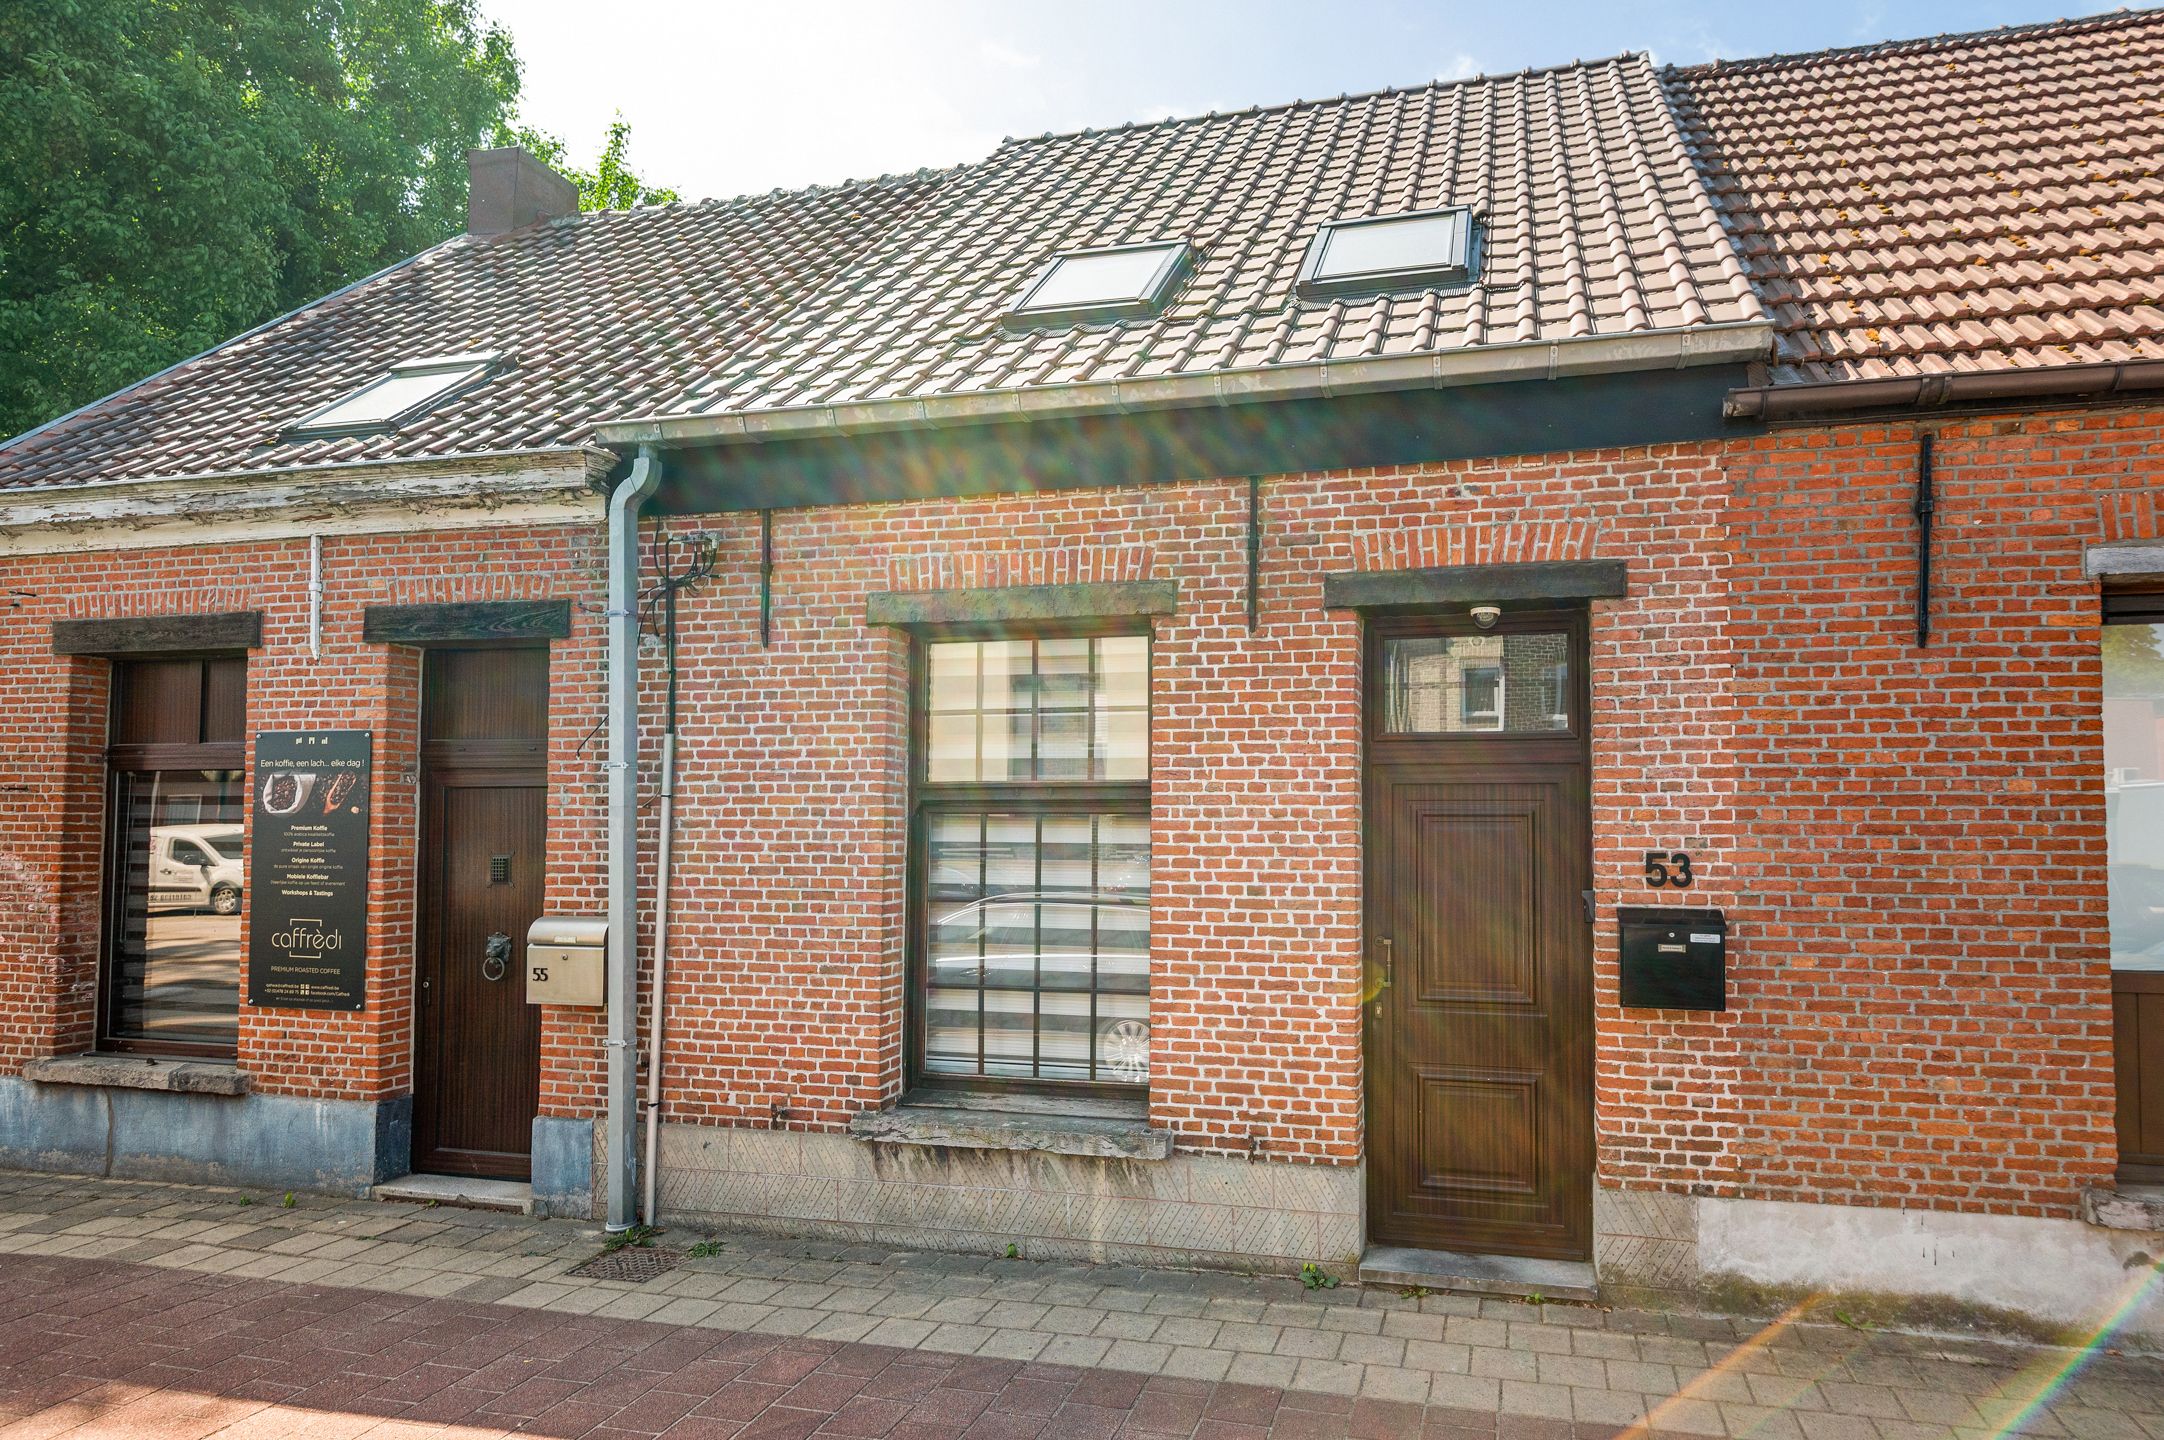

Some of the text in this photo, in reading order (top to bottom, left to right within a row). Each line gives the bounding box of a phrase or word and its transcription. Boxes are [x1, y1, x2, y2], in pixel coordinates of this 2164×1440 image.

[275, 760, 295, 768] koffie,
[347, 760, 360, 768] dag
[1646, 852, 1692, 887] 53
[532, 968, 548, 981] 55
